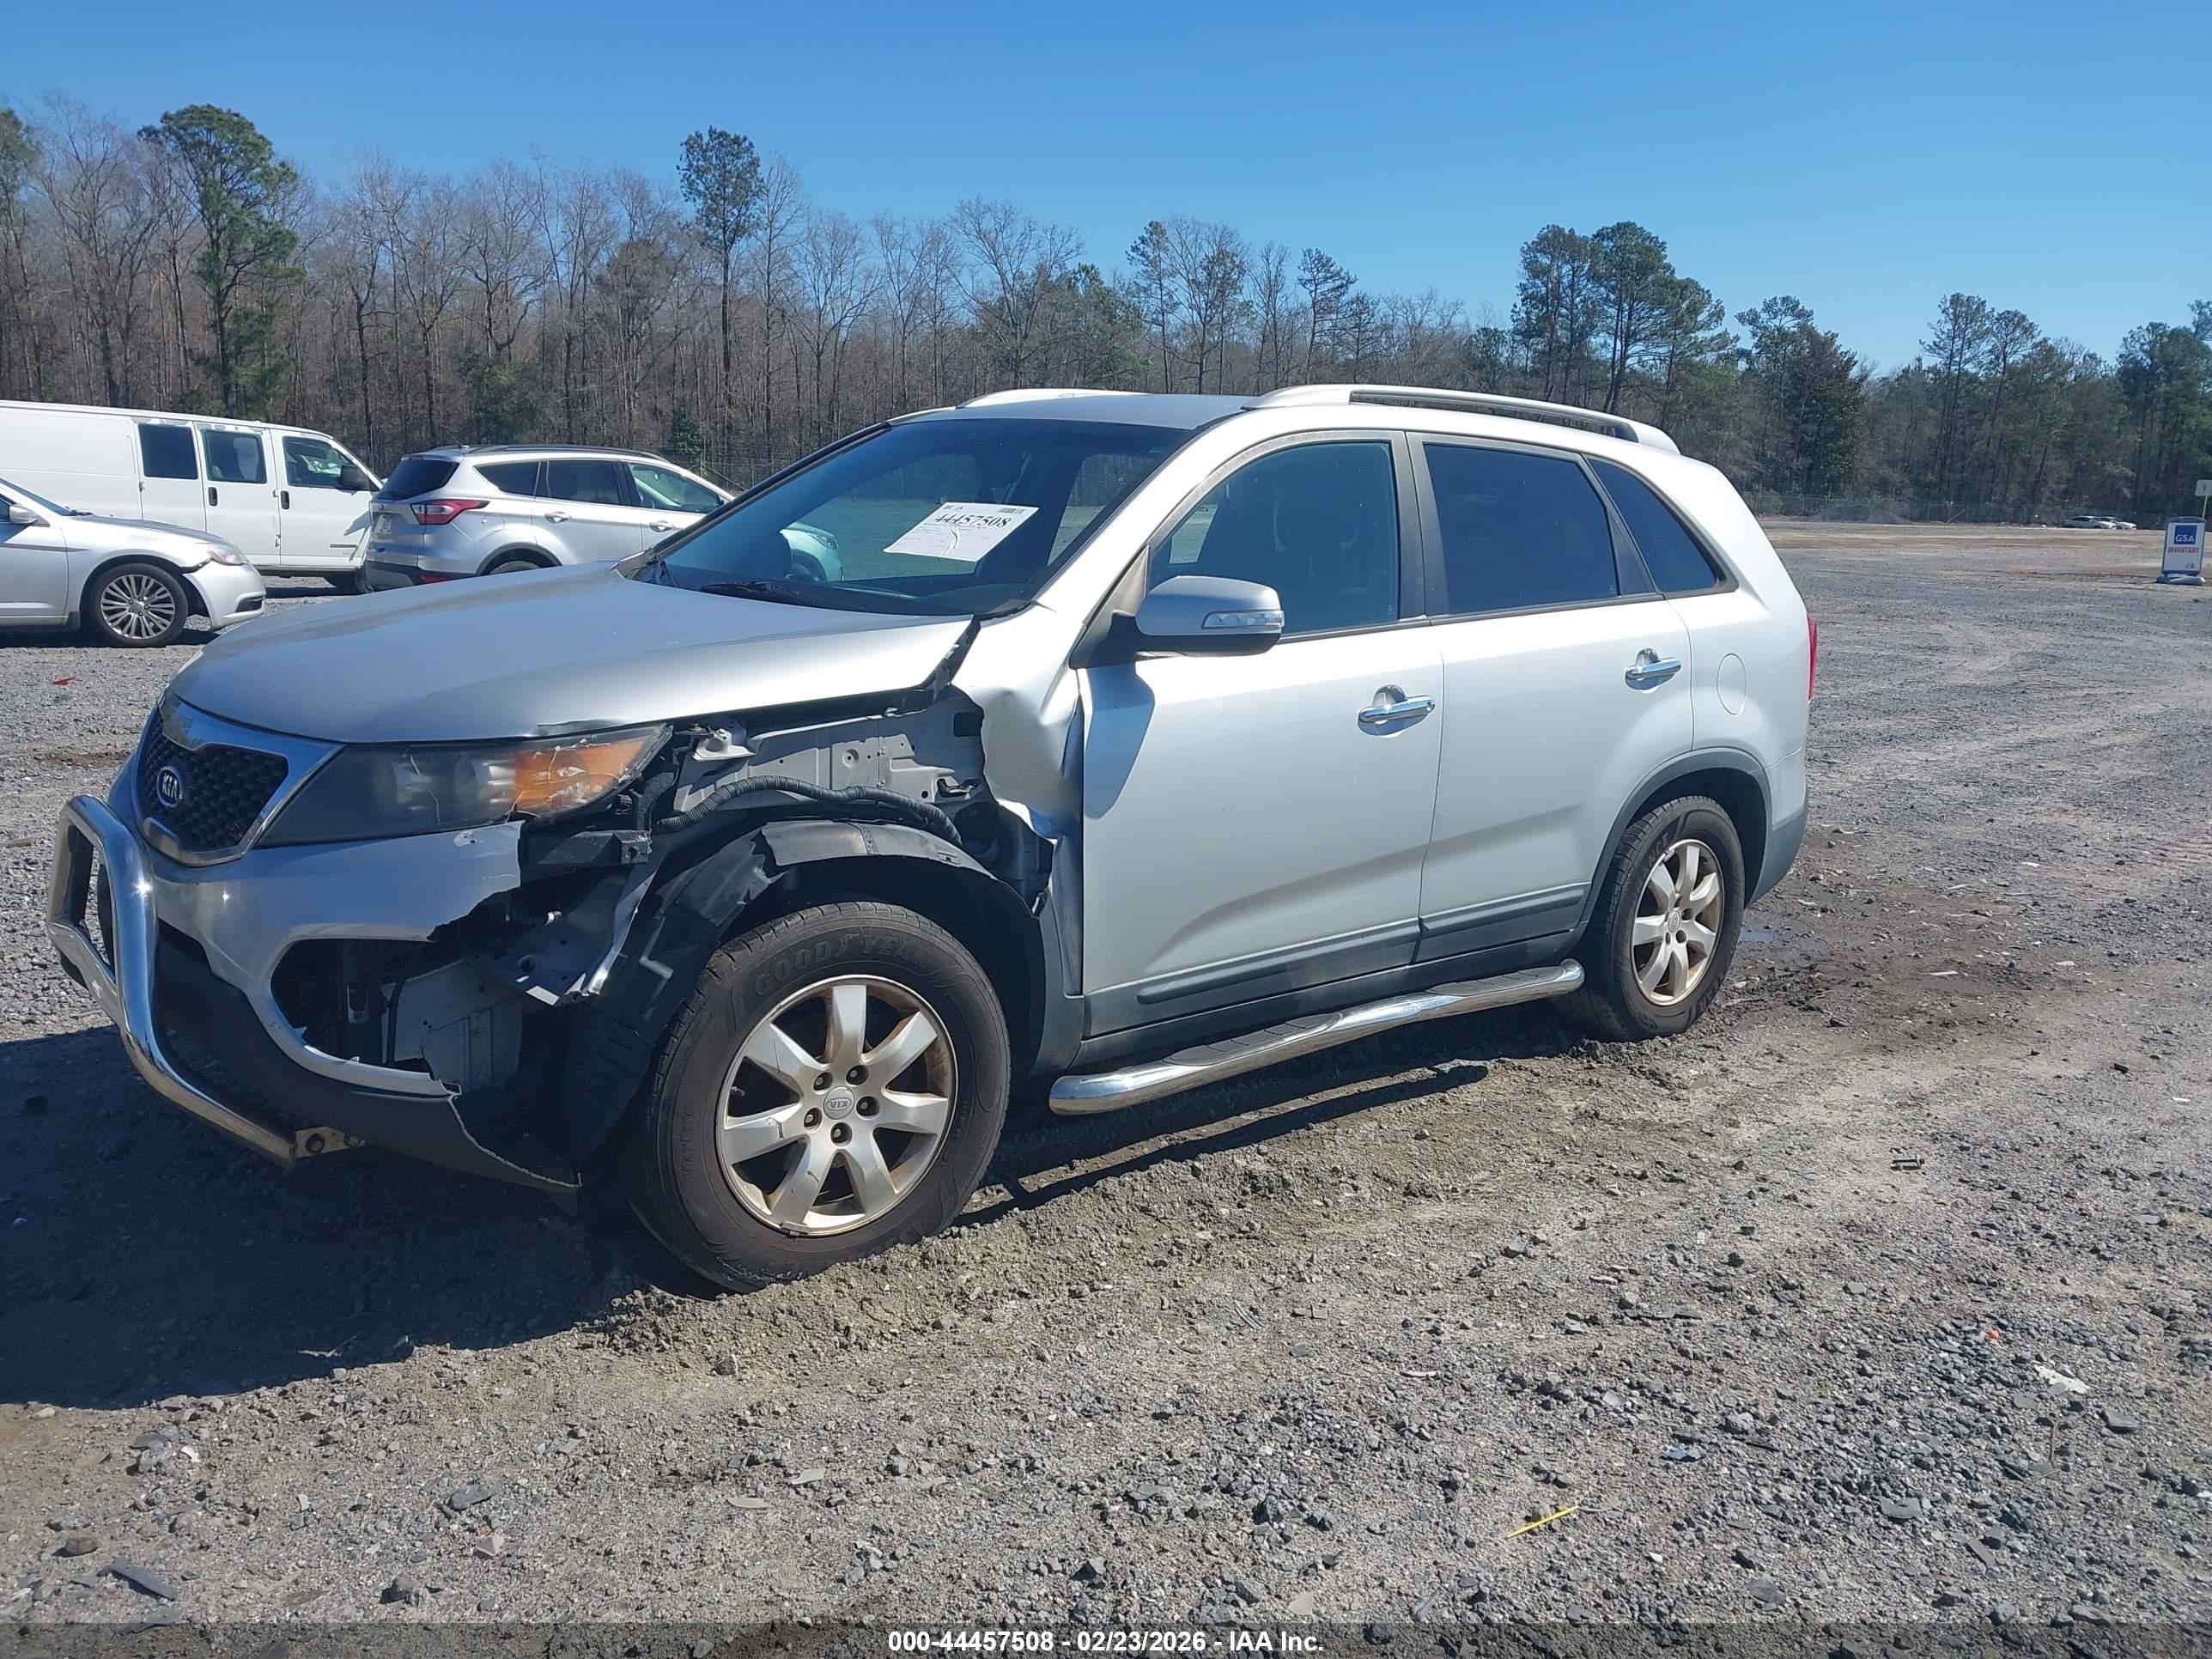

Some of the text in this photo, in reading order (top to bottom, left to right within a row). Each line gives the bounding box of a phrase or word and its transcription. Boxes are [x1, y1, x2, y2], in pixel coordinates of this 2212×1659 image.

[935, 514, 1012, 528] 44457508
[2175, 534, 2196, 543] GSA
[162, 773, 178, 800] KIA
[830, 1098, 849, 1109] KIA
